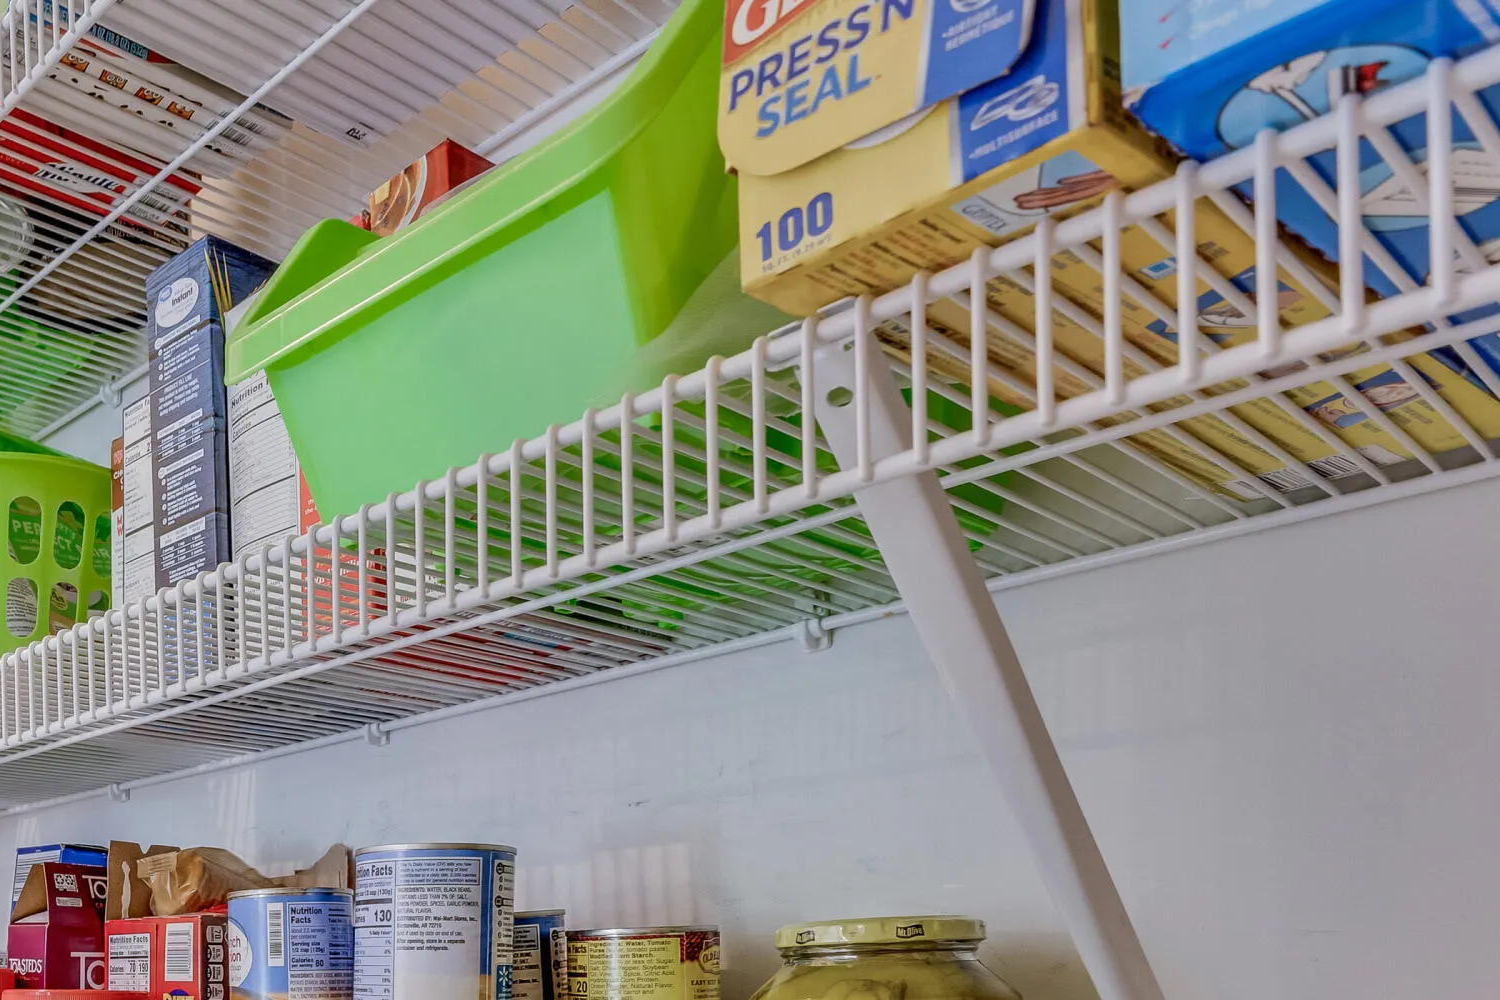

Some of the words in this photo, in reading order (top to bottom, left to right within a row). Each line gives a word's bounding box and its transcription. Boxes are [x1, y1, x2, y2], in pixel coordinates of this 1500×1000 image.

[754, 55, 872, 139] SEAL
[756, 192, 833, 261] 100
[231, 382, 264, 409] Nutrition
[372, 865, 393, 876] Facts
[290, 907, 322, 915] Nutrition
[375, 910, 392, 922] 130
[291, 916, 311, 924] Facts
[572, 945, 587, 954] Facts
[9, 958, 43, 976] TOASTEDS
[139, 962, 149, 972] 190
[316, 960, 324, 968] 80
[576, 980, 588, 993] 20
